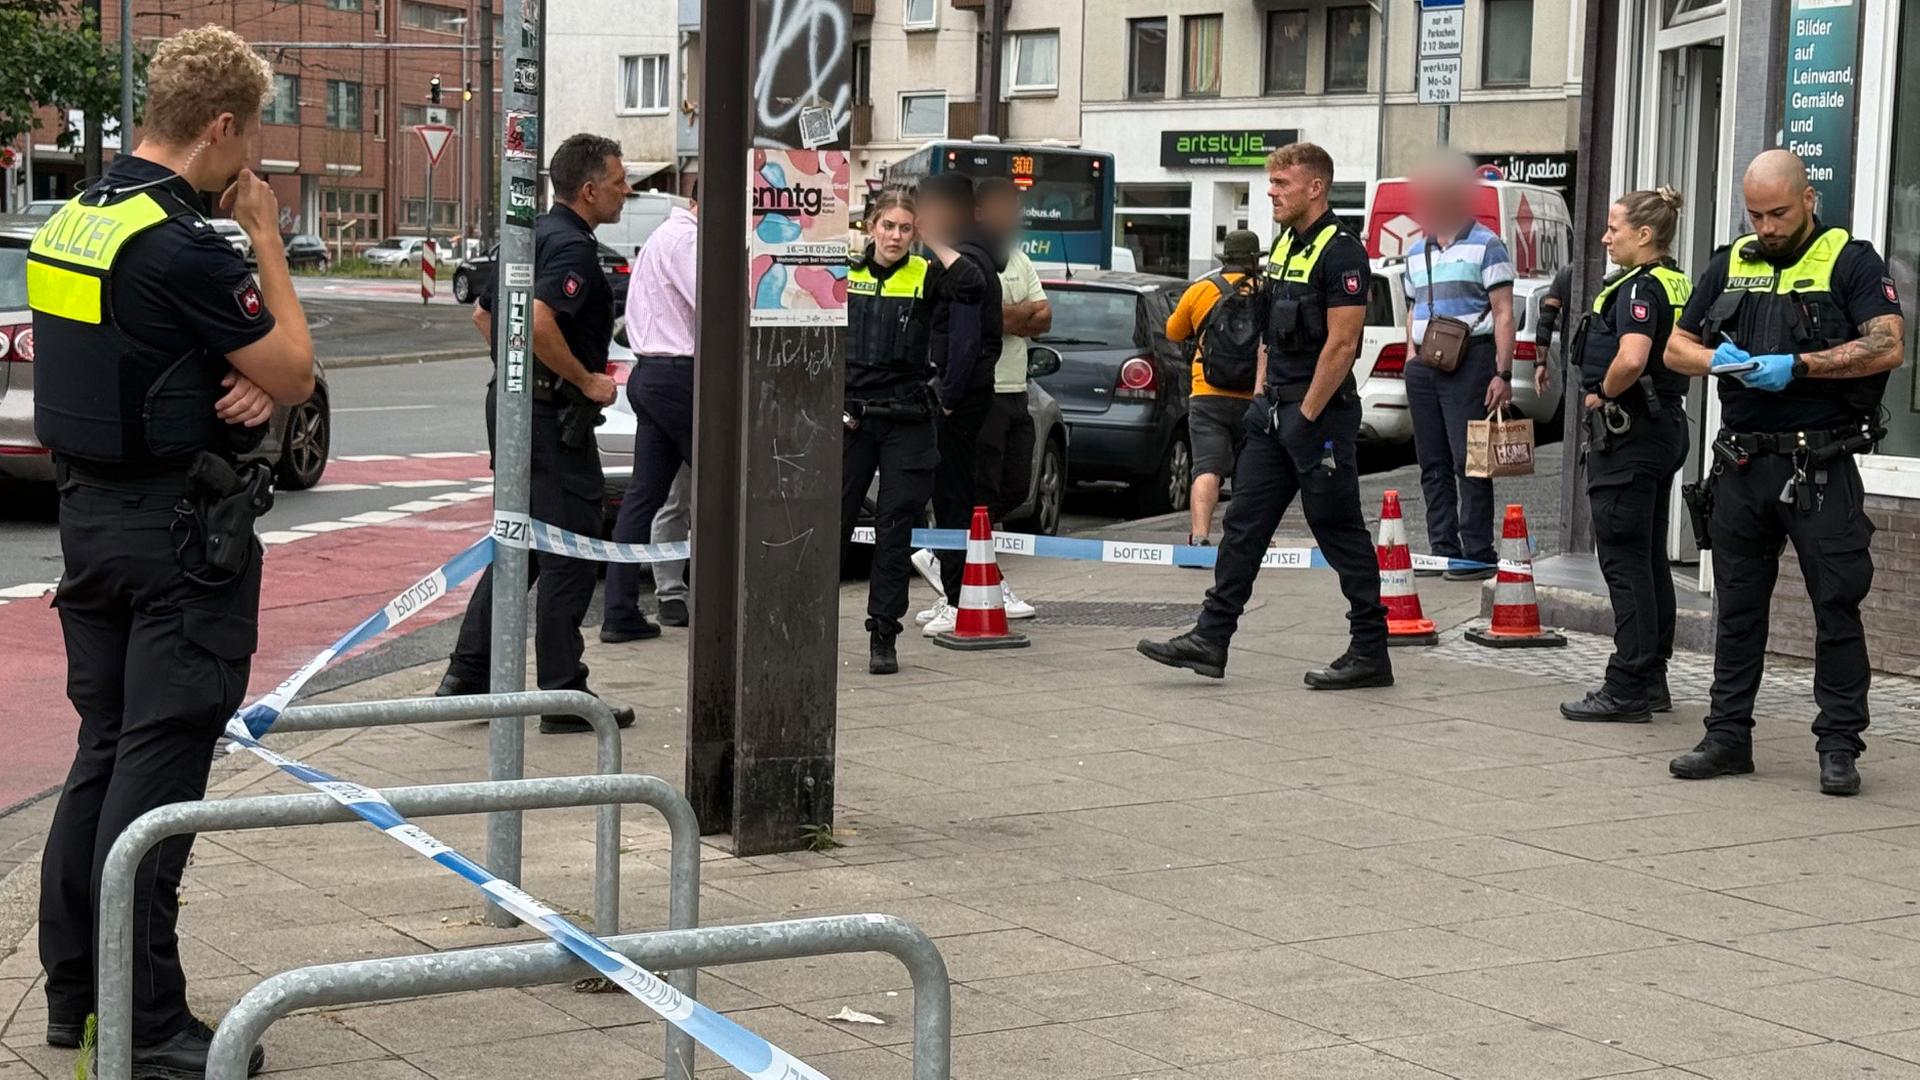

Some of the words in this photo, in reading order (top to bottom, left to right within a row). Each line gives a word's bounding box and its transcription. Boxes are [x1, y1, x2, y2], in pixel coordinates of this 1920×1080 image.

[1796, 20, 1832, 36] Bilder
[1794, 43, 1815, 61] auf
[1423, 62, 1458, 74] werktags
[1793, 66, 1853, 86] Leinwand,
[1427, 75, 1452, 86] Mo-Sa
[1792, 91, 1844, 109] Gemälde
[1790, 116, 1813, 133] und
[1176, 132, 1264, 156] artstyle
[1789, 140, 1823, 157] Fotos
[1011, 156, 1034, 175] 300
[1525, 158, 1567, 182] مطعم
[752, 182, 822, 217] snntg
[1023, 207, 1062, 219] lobus.de
[1666, 277, 1690, 302] PO
[1727, 277, 1774, 288] POLIZEI
